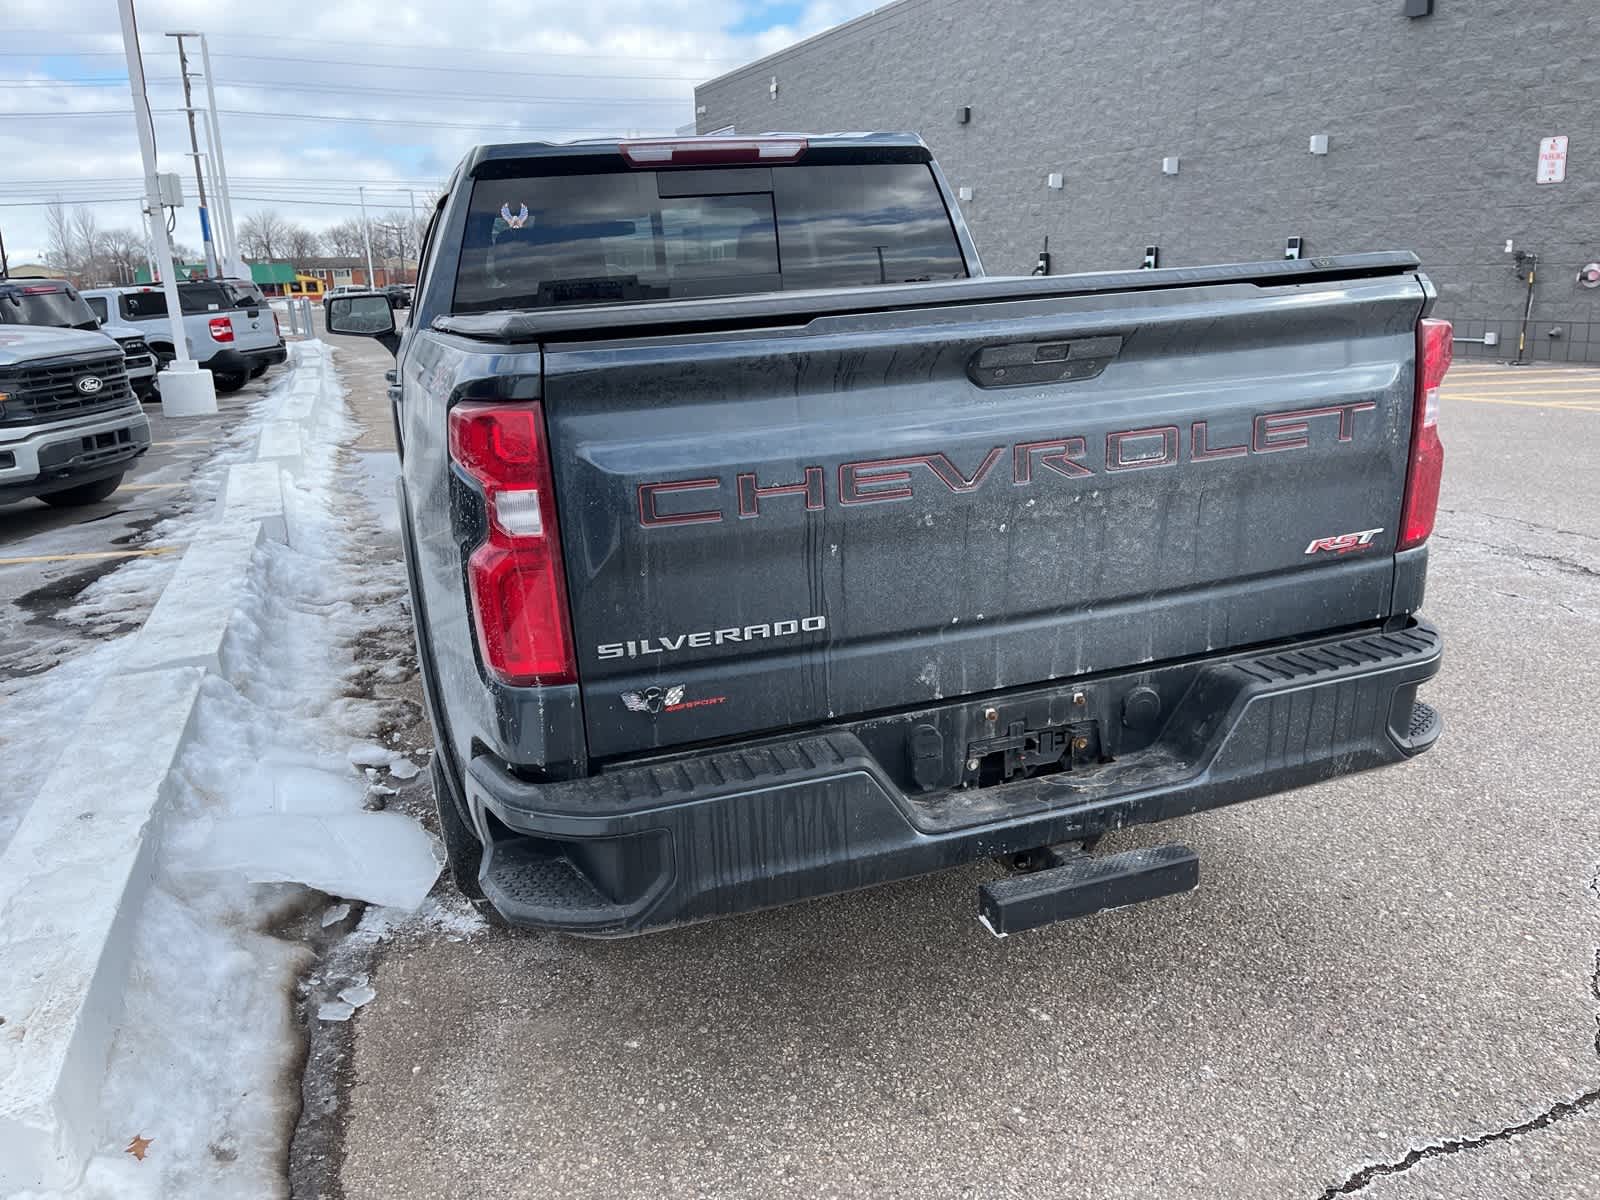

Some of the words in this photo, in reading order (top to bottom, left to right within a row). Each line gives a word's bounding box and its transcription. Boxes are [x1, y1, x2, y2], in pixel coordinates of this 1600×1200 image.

[637, 402, 1376, 528] CHEVROLET
[1304, 527, 1384, 554] RST
[598, 615, 826, 660] SILVERADO
